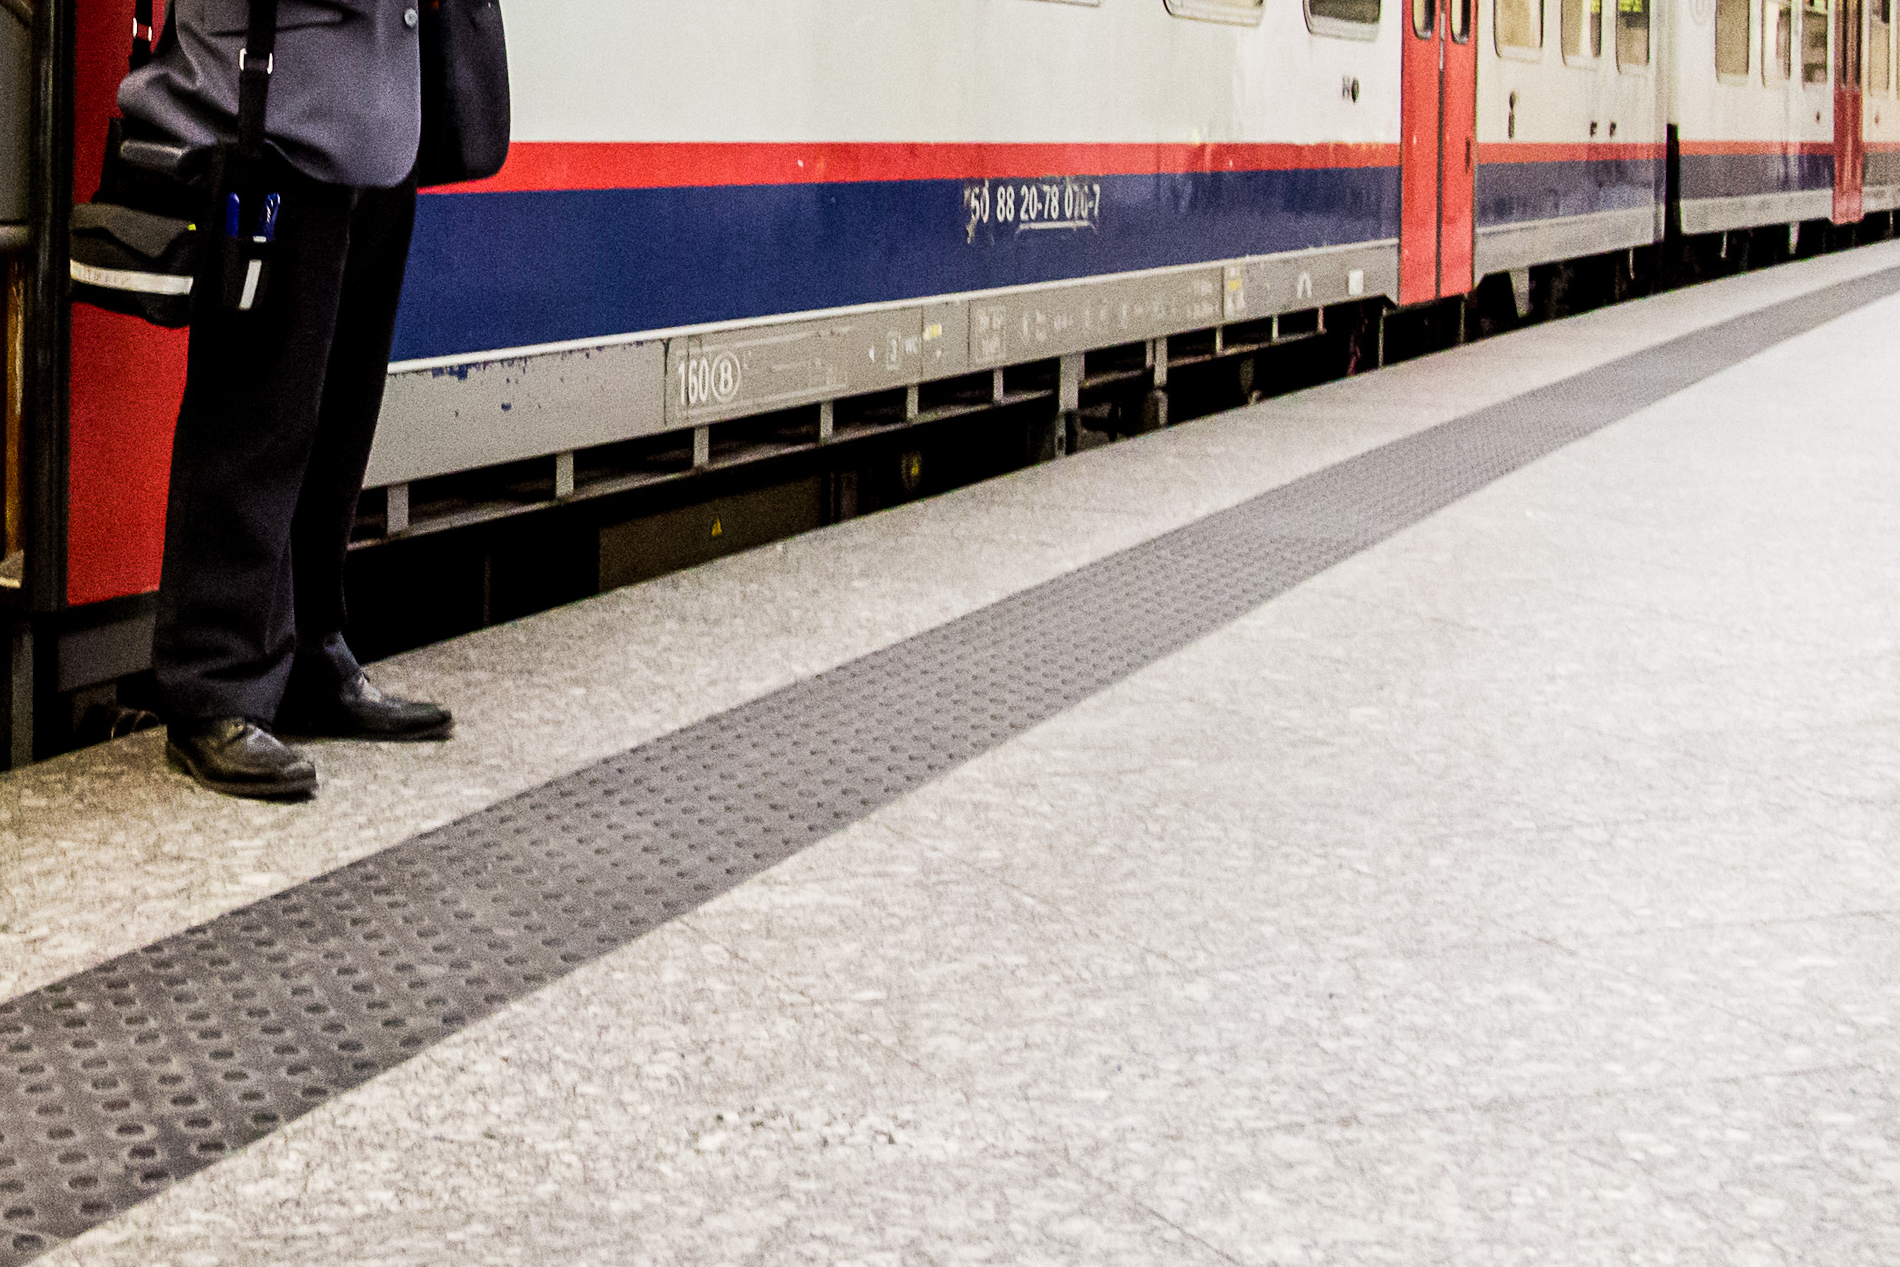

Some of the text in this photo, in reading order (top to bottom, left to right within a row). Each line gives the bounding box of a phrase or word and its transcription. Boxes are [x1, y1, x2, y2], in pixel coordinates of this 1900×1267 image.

[996, 185, 1015, 223] 88
[1020, 184, 1060, 221] 20-78
[678, 357, 709, 405] 160
